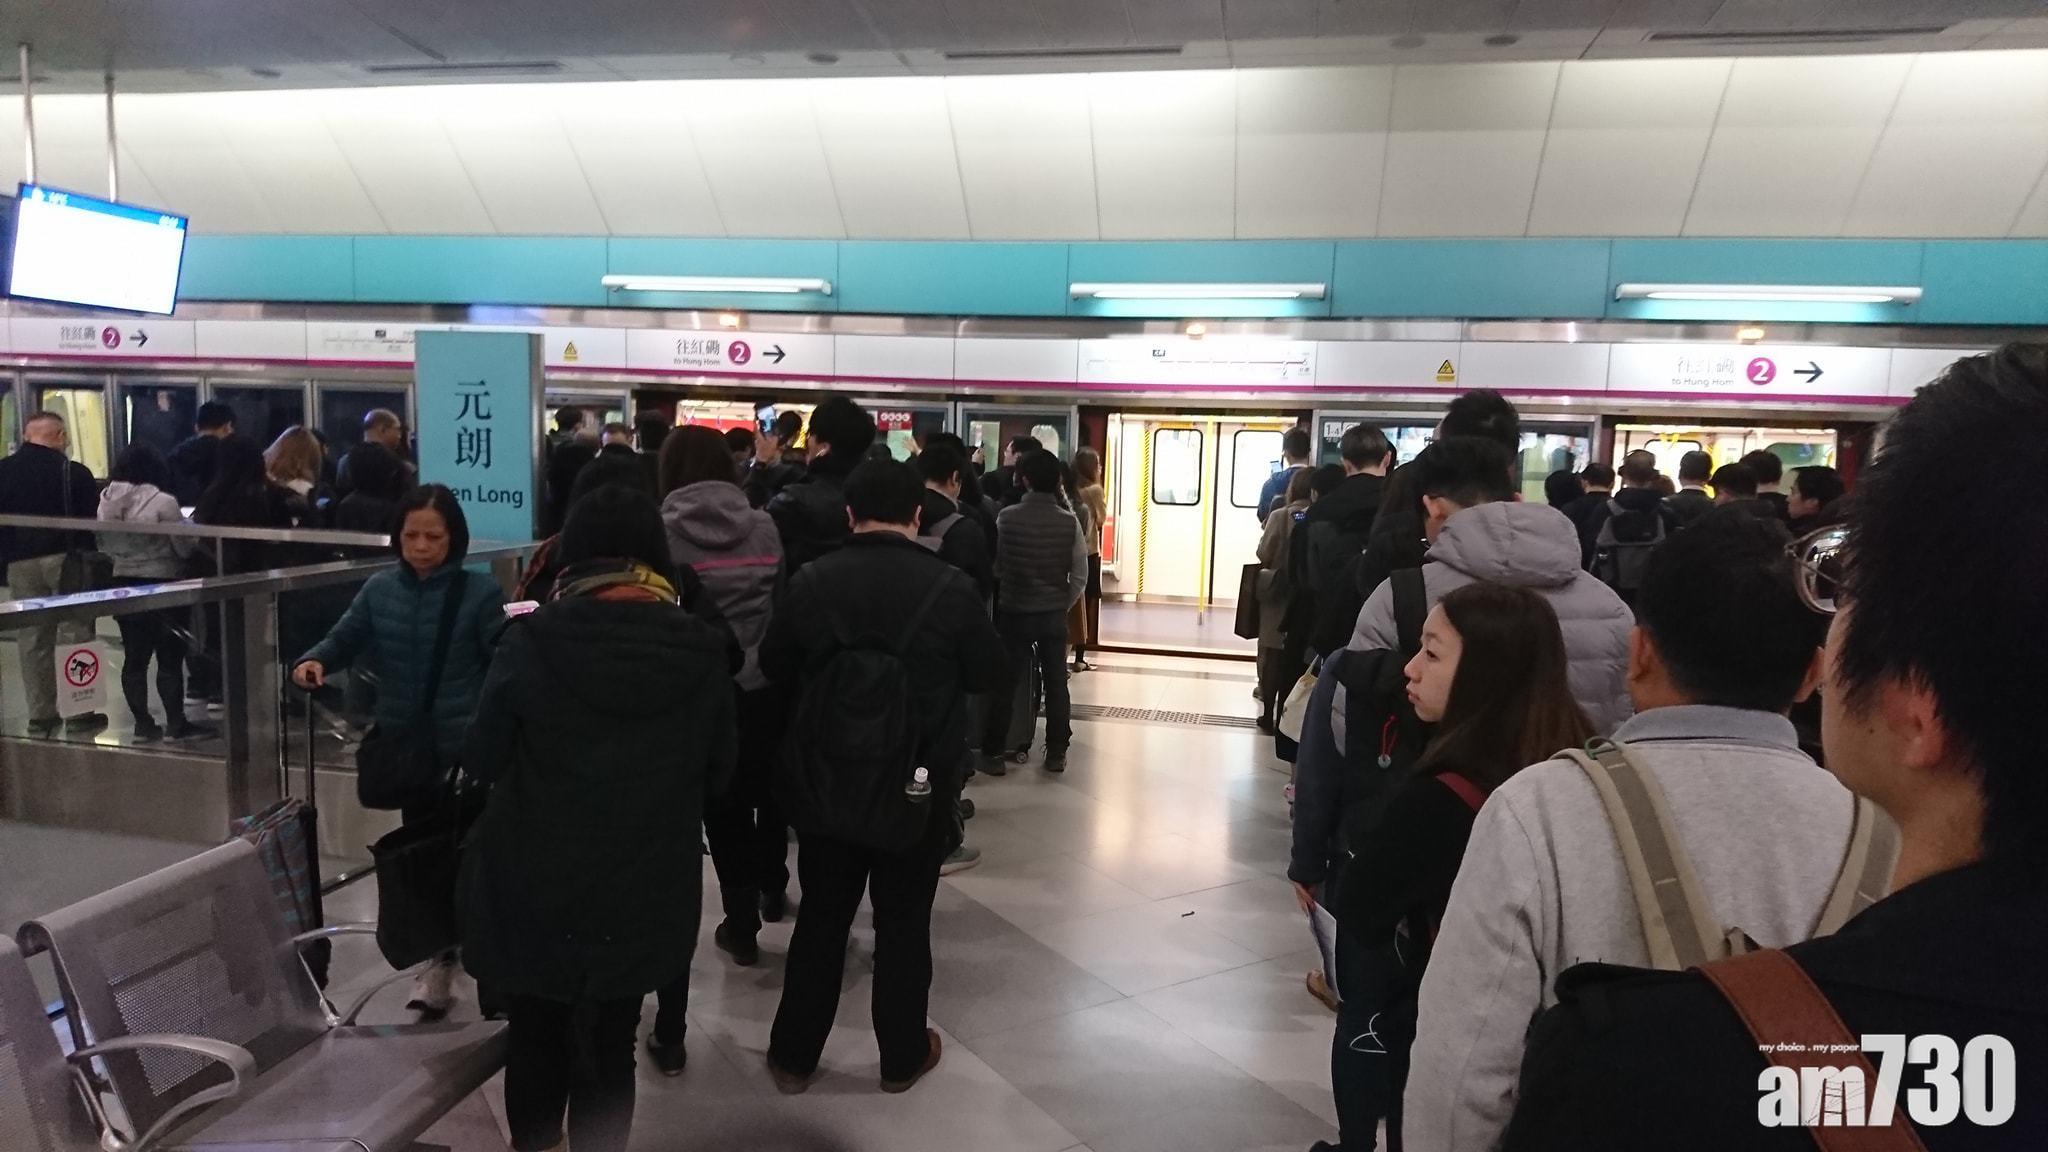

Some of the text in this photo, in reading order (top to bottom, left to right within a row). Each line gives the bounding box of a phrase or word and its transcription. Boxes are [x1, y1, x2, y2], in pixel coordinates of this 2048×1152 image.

[1684, 378, 1709, 387] Hung
[1712, 378, 1734, 386] Hom
[454, 379, 493, 470] 元朗
[477, 483, 524, 509] Long
